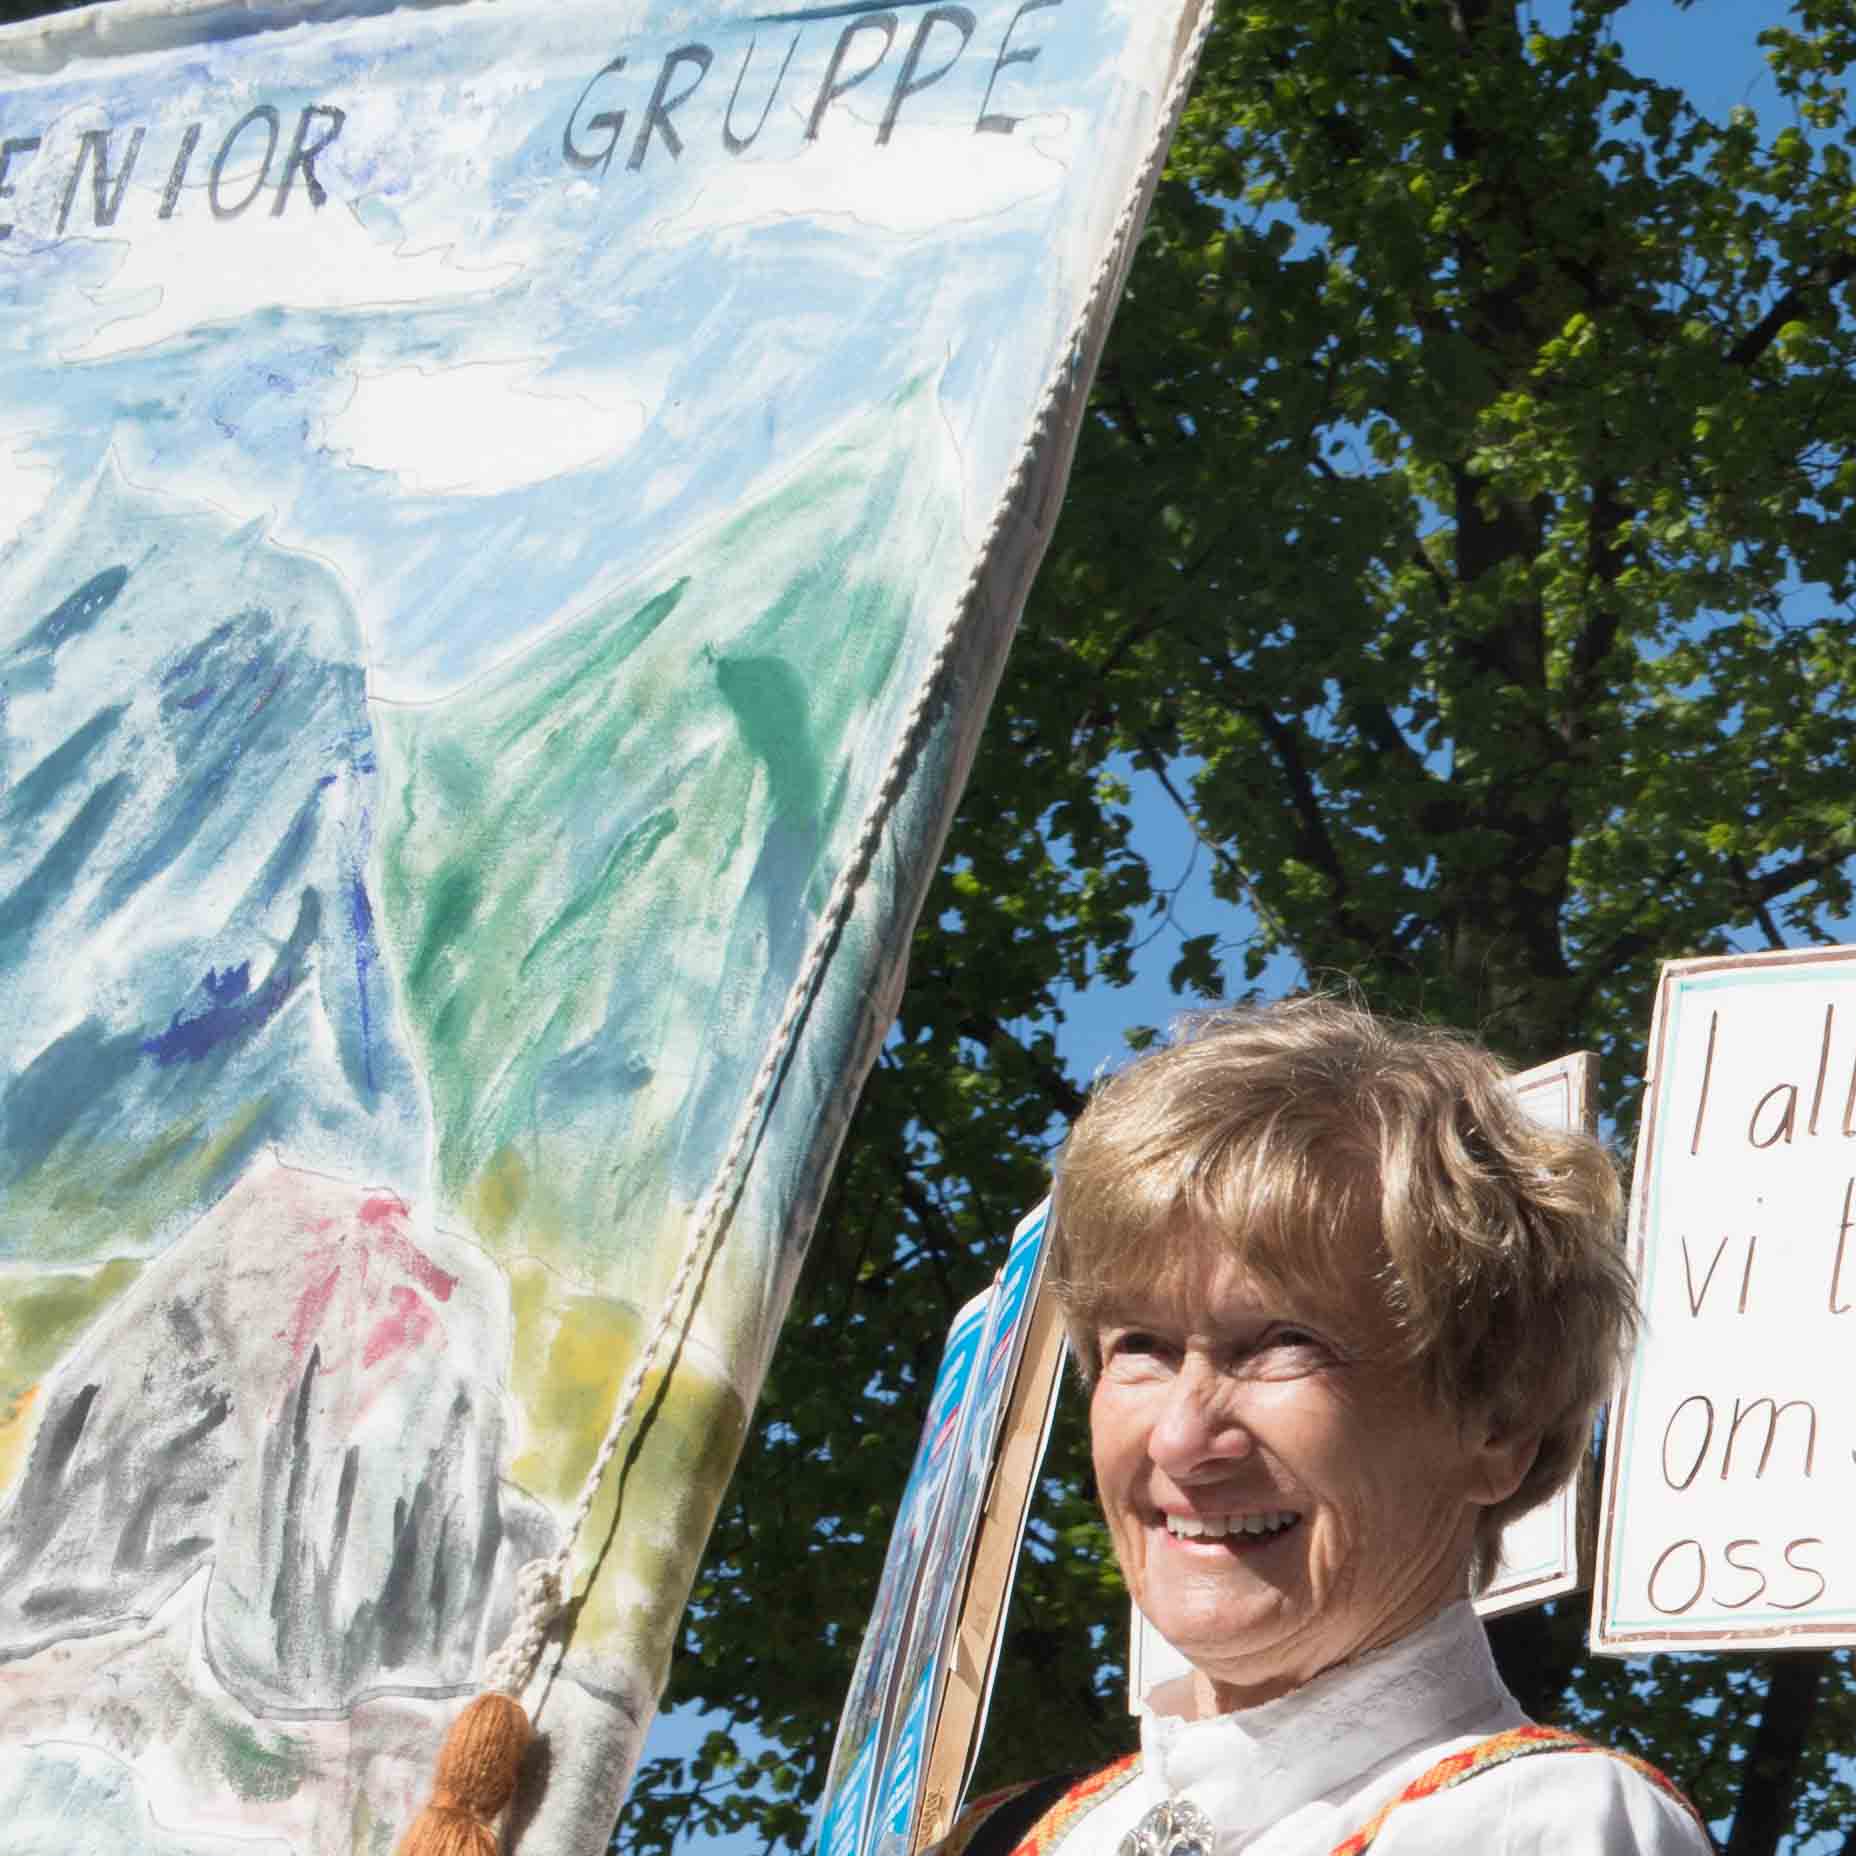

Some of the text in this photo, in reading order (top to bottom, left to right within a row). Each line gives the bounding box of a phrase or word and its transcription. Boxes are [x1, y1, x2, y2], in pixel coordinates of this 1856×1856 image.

[0, 0, 1063, 238] ENIOR GRUPPE
[1681, 1194, 1757, 1318] vi
[1661, 1395, 1818, 1492] om
[1646, 1537, 1826, 1615] oss
